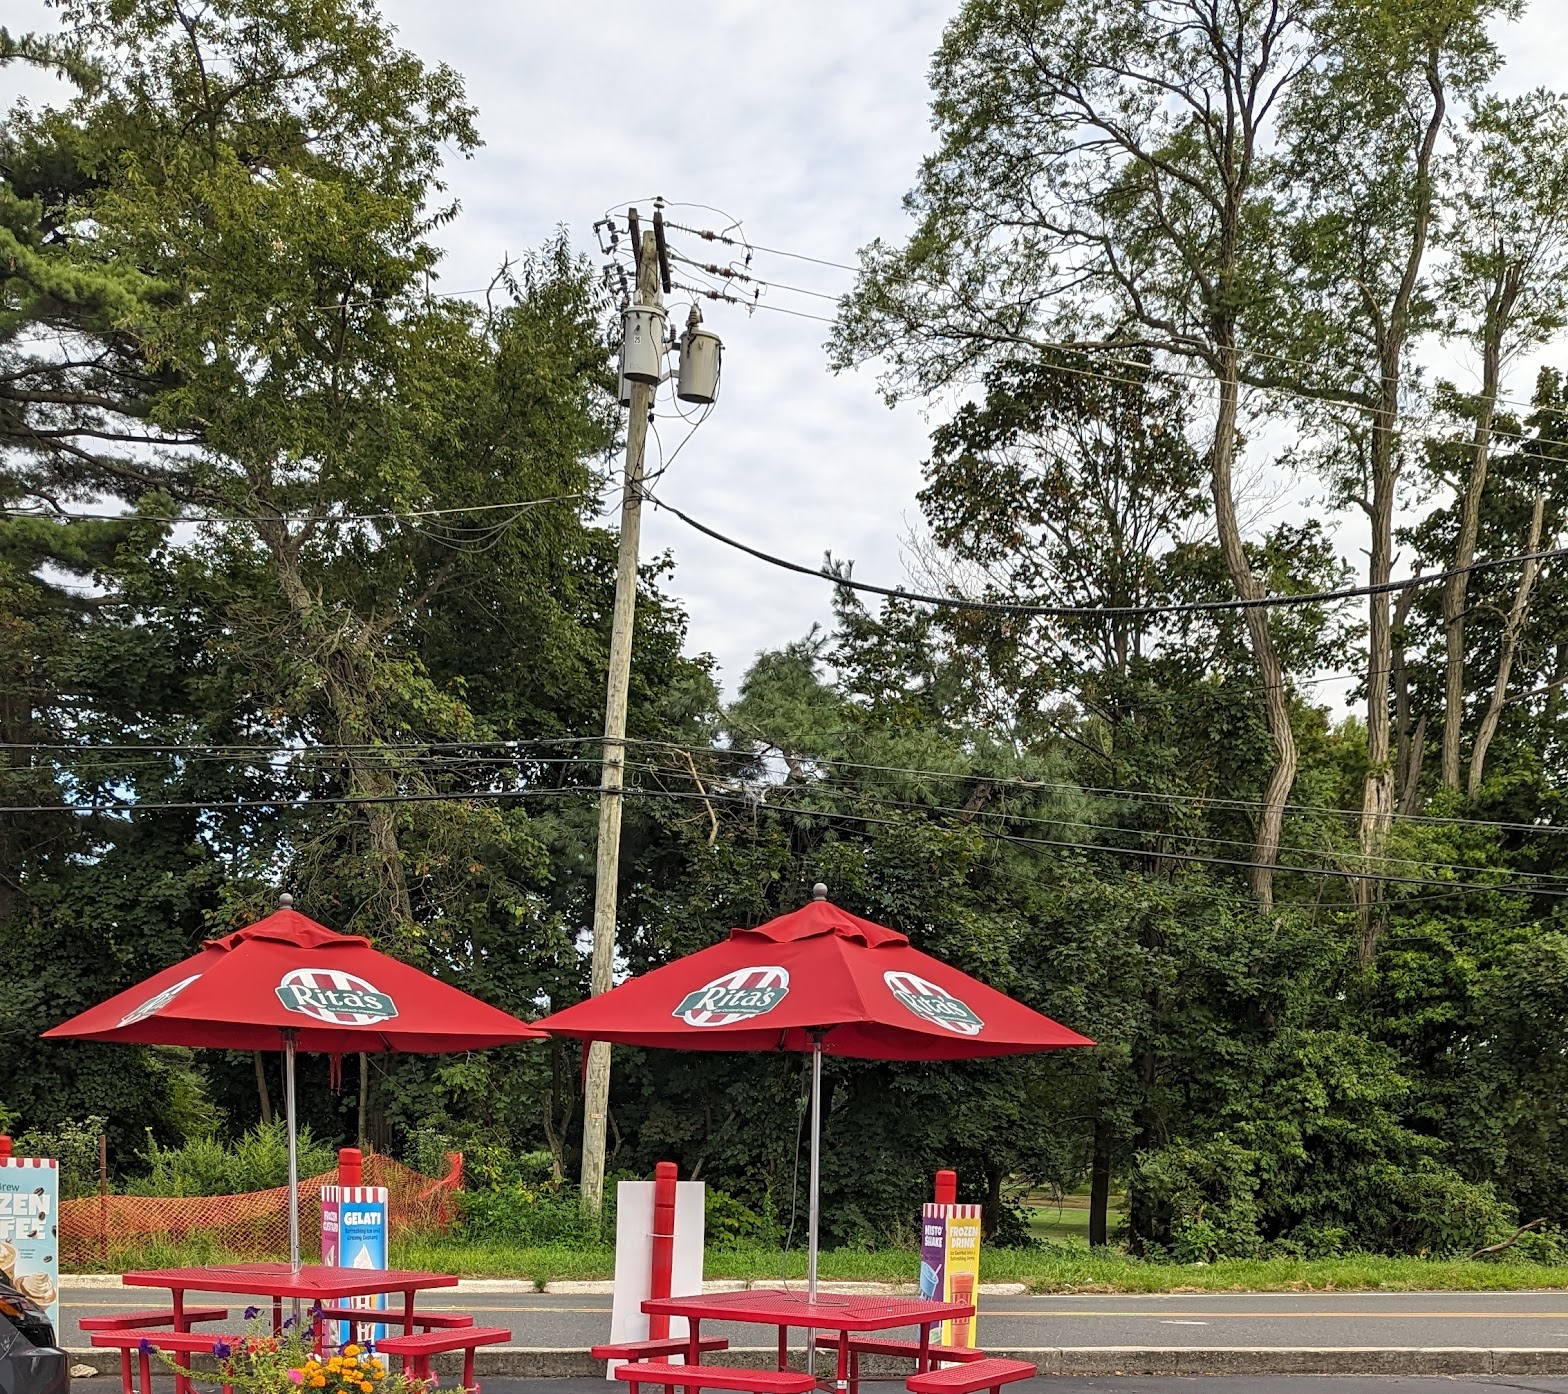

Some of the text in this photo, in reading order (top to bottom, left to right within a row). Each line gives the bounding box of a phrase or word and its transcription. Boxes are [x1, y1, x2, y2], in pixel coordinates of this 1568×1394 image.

[288, 984, 383, 1010] Rita's
[693, 987, 775, 1011] Rita's
[895, 989, 968, 1018] Rita's
[344, 1212, 381, 1226] GELATI
[950, 1226, 979, 1237] FROZEN
[924, 1235, 943, 1248] SHAKE
[951, 1237, 976, 1248] DRINK
